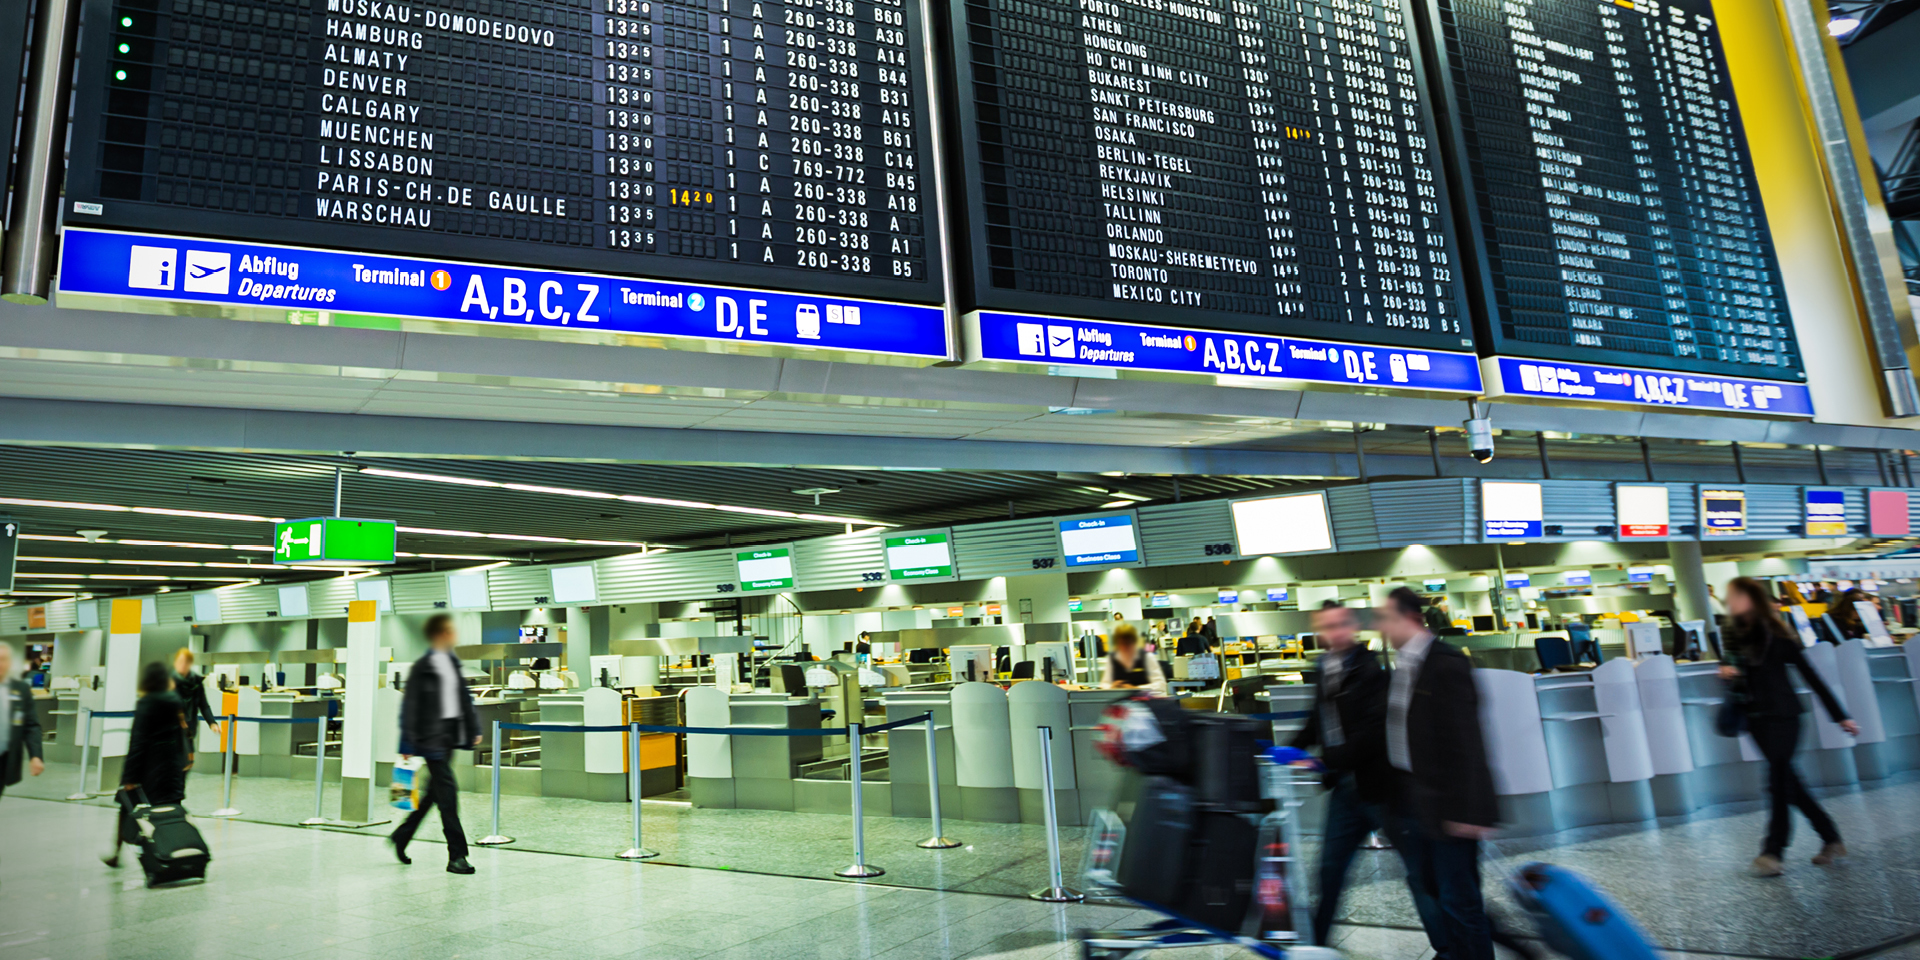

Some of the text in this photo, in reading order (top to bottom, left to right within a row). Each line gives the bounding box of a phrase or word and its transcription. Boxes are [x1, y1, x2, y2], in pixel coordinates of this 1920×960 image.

[874, 8, 902, 26] B60
[1080, 0, 1119, 17] PORTO
[722, 0, 904, 46] 1 A 260-338 A30
[1082, 15, 1122, 35] ATHEN
[328, 0, 554, 47] MOSKAU-DOMODEDOVO
[724, 61, 730, 76] 1
[756, 66, 766, 82] A
[788, 72, 859, 98] 260-338
[880, 88, 908, 106] B31
[722, 18, 729, 32] 1
[753, 24, 764, 39] A
[786, 30, 856, 56] 260-338
[877, 48, 905, 66] A14
[1084, 33, 1147, 58] HONGKONG
[327, 18, 422, 49] HAMBURG
[725, 83, 731, 98] 1
[756, 88, 767, 104] A
[789, 94, 860, 119] 260-338
[882, 109, 910, 127] A15
[722, 39, 730, 54] 1
[754, 45, 765, 60] A
[787, 51, 858, 77] 260-338
[879, 68, 907, 86] B44
[1086, 51, 1208, 88] HO CHI MINH CITY
[1088, 70, 1150, 94] BUKAREST
[324, 44, 408, 71] ALMATY
[726, 105, 732, 120] 1
[757, 110, 768, 126] A
[790, 115, 862, 140] 260-338
[883, 130, 911, 148] B61
[1090, 88, 1214, 124] SANKT PETERSBURG
[324, 68, 406, 96] DENVER
[726, 127, 733, 143] 1
[758, 132, 768, 148] A
[791, 137, 863, 162] 260-338
[885, 151, 914, 170] C14
[1093, 107, 1194, 138] SAN FRANCISCO
[1529, 116, 1552, 130] RIGA
[322, 94, 420, 123] CALGARY
[727, 150, 733, 165] 1
[759, 154, 768, 170] C
[792, 159, 865, 184] 769-772
[886, 172, 915, 191] B45
[1095, 126, 1136, 145] OSAKA
[320, 119, 433, 150] MUENCHEN
[728, 172, 734, 188] 1
[760, 177, 770, 193] A
[794, 181, 866, 206] 260-338
[888, 194, 916, 212] A18
[1097, 144, 1192, 173] BERLIN-TEGEL
[1540, 161, 1576, 178] ZUERICH
[320, 145, 432, 176] LISSABON
[729, 196, 735, 212] 1
[762, 200, 772, 216] A
[795, 204, 868, 228] 260-338
[890, 216, 900, 232] A
[1100, 164, 1172, 188] REYKJAVIK
[1102, 184, 1164, 206] HELSINKI
[1545, 191, 1571, 206] DUBAI
[318, 172, 472, 206] PARIS-CH.DE
[489, 191, 566, 216] GAULLE
[730, 219, 736, 235] 1
[762, 223, 772, 239] A
[796, 226, 869, 250] 260-338
[892, 238, 909, 254] A1
[1104, 203, 1161, 224] TALLINN
[1548, 207, 1601, 226] KOPENHAGEN
[316, 198, 430, 227] WARSCHAU
[731, 242, 737, 258] 1
[764, 246, 774, 262] A
[797, 250, 870, 272] 260-338
[893, 260, 912, 277] B5
[1106, 223, 1163, 244] ORLANDO
[238, 254, 299, 280] Abflug
[1108, 243, 1257, 274] MOSKAU-SHEREMETYEVO
[1380, 277, 1424, 294] 261-963
[1558, 253, 1596, 269] BANGKOK
[236, 278, 336, 304] Departures
[1110, 263, 1168, 283] TORONTO
[1382, 295, 1427, 312] 260-338
[1564, 284, 1602, 301] BELGRAD
[352, 264, 425, 288] Terminal
[460, 274, 599, 324] A,B,C,Z
[620, 287, 682, 308] Terminal
[716, 296, 768, 338] D,E
[1113, 284, 1162, 302] MEXICO
[1170, 289, 1201, 306] CITY
[1386, 312, 1430, 330] 260-338
[1568, 300, 1614, 317] STUTTGART
[1078, 328, 1112, 346] Abflug
[1571, 317, 1604, 331] ANKARA
[1080, 345, 1134, 363] Departures
[1140, 332, 1182, 350] Terminal
[1204, 338, 1282, 375] A,B,C,Z
[1289, 345, 1326, 362] Terminal
[1343, 350, 1378, 383] D,E
[1078, 520, 1106, 528] Check-in
[1032, 558, 1054, 570] 537
